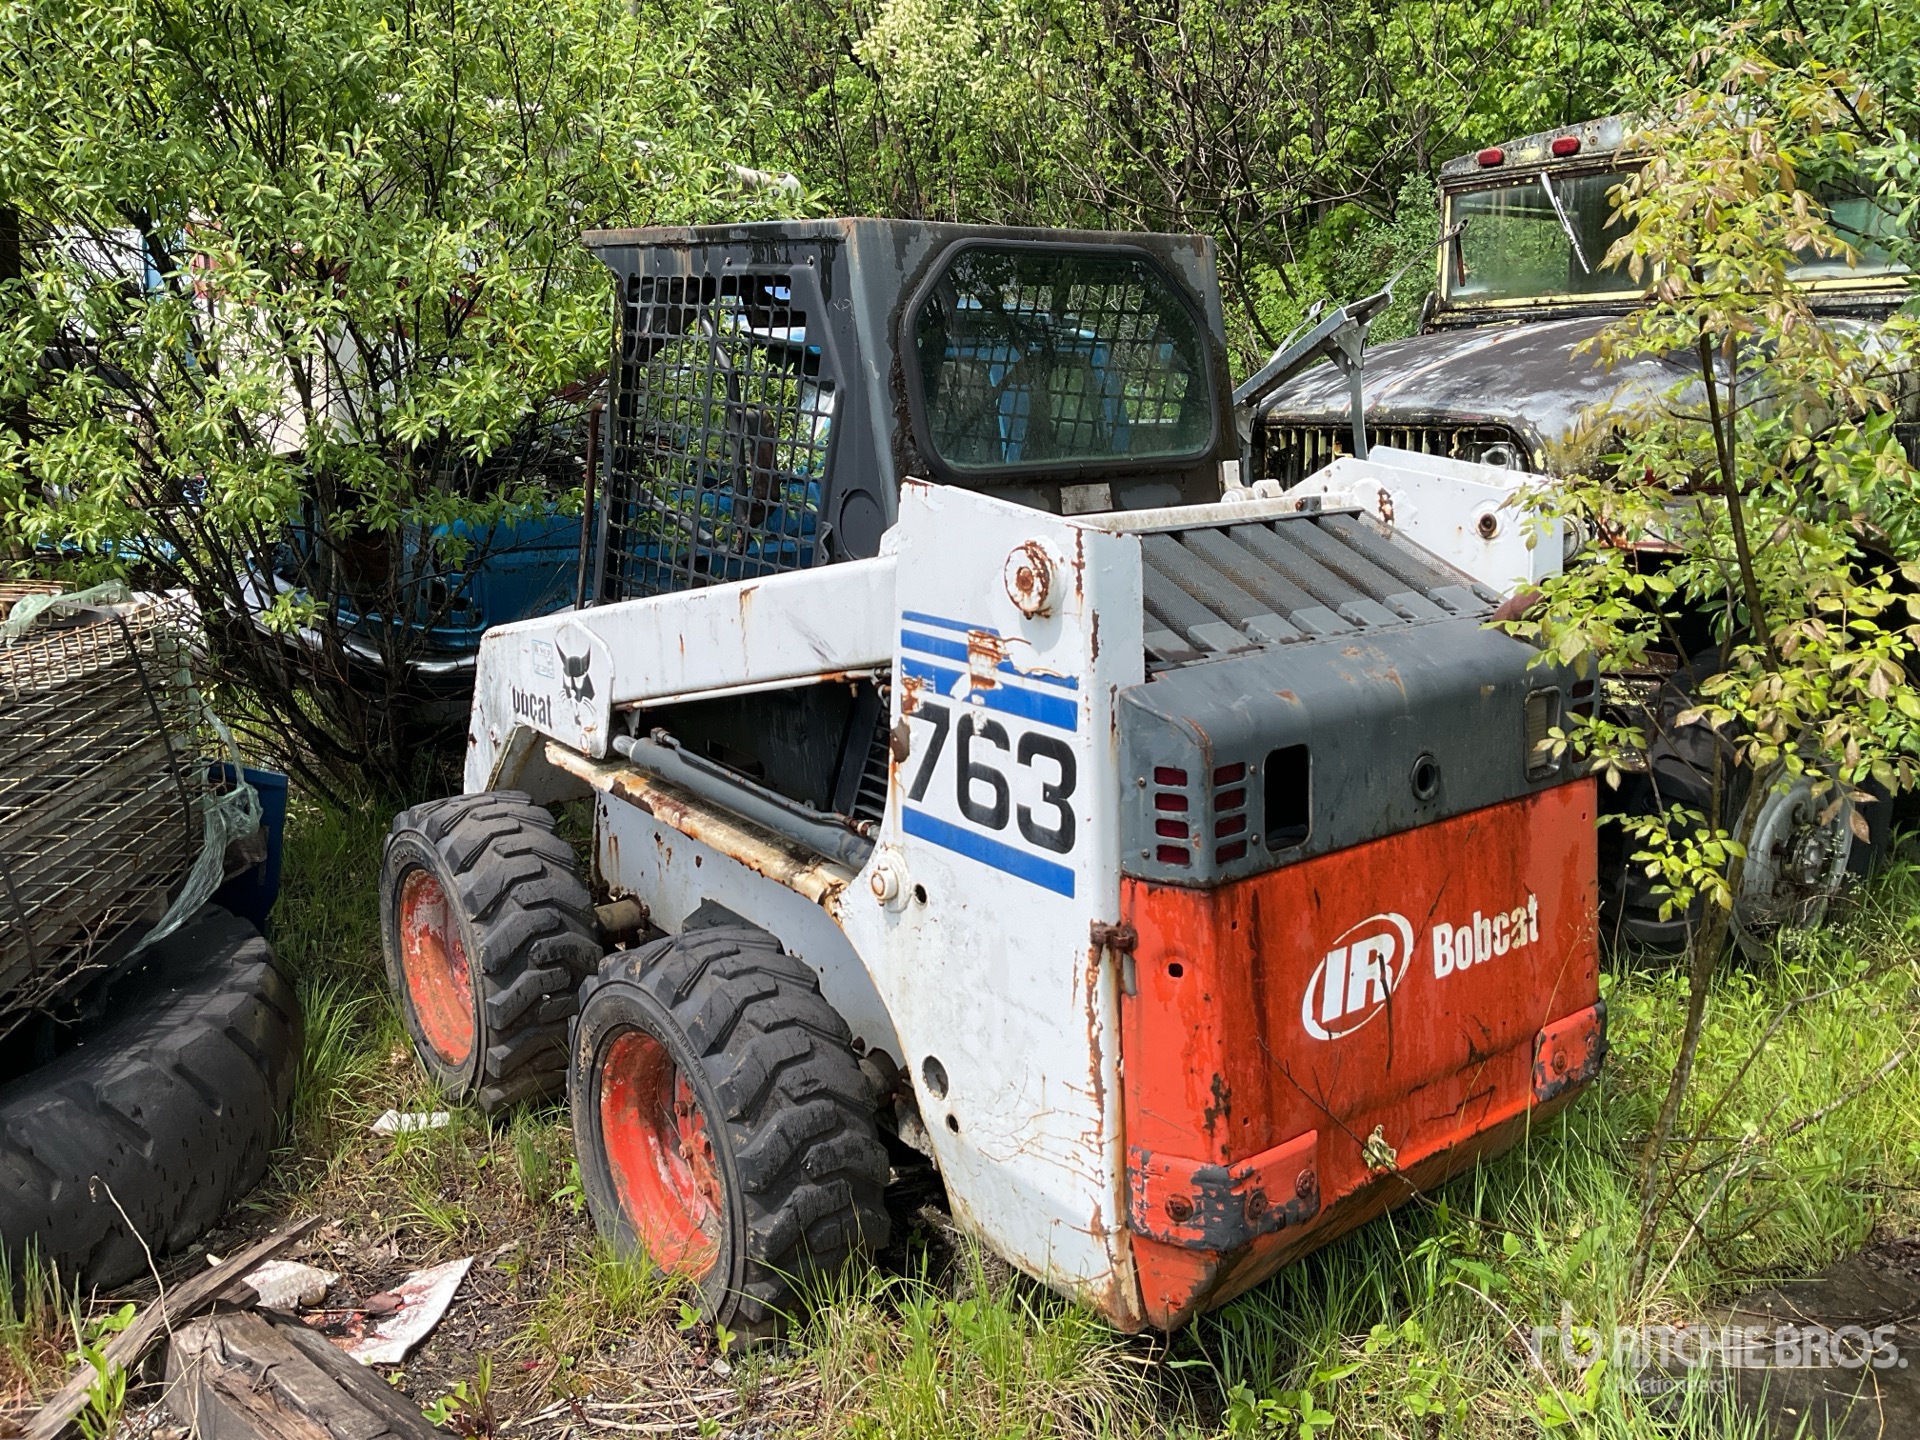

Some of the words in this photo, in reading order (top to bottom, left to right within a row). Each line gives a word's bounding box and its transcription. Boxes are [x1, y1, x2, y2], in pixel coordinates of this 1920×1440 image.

[509, 681, 552, 729] obcat
[902, 701, 1076, 855] 763
[1321, 932, 1396, 1024] IR
[1432, 893, 1539, 980] Bobcat
